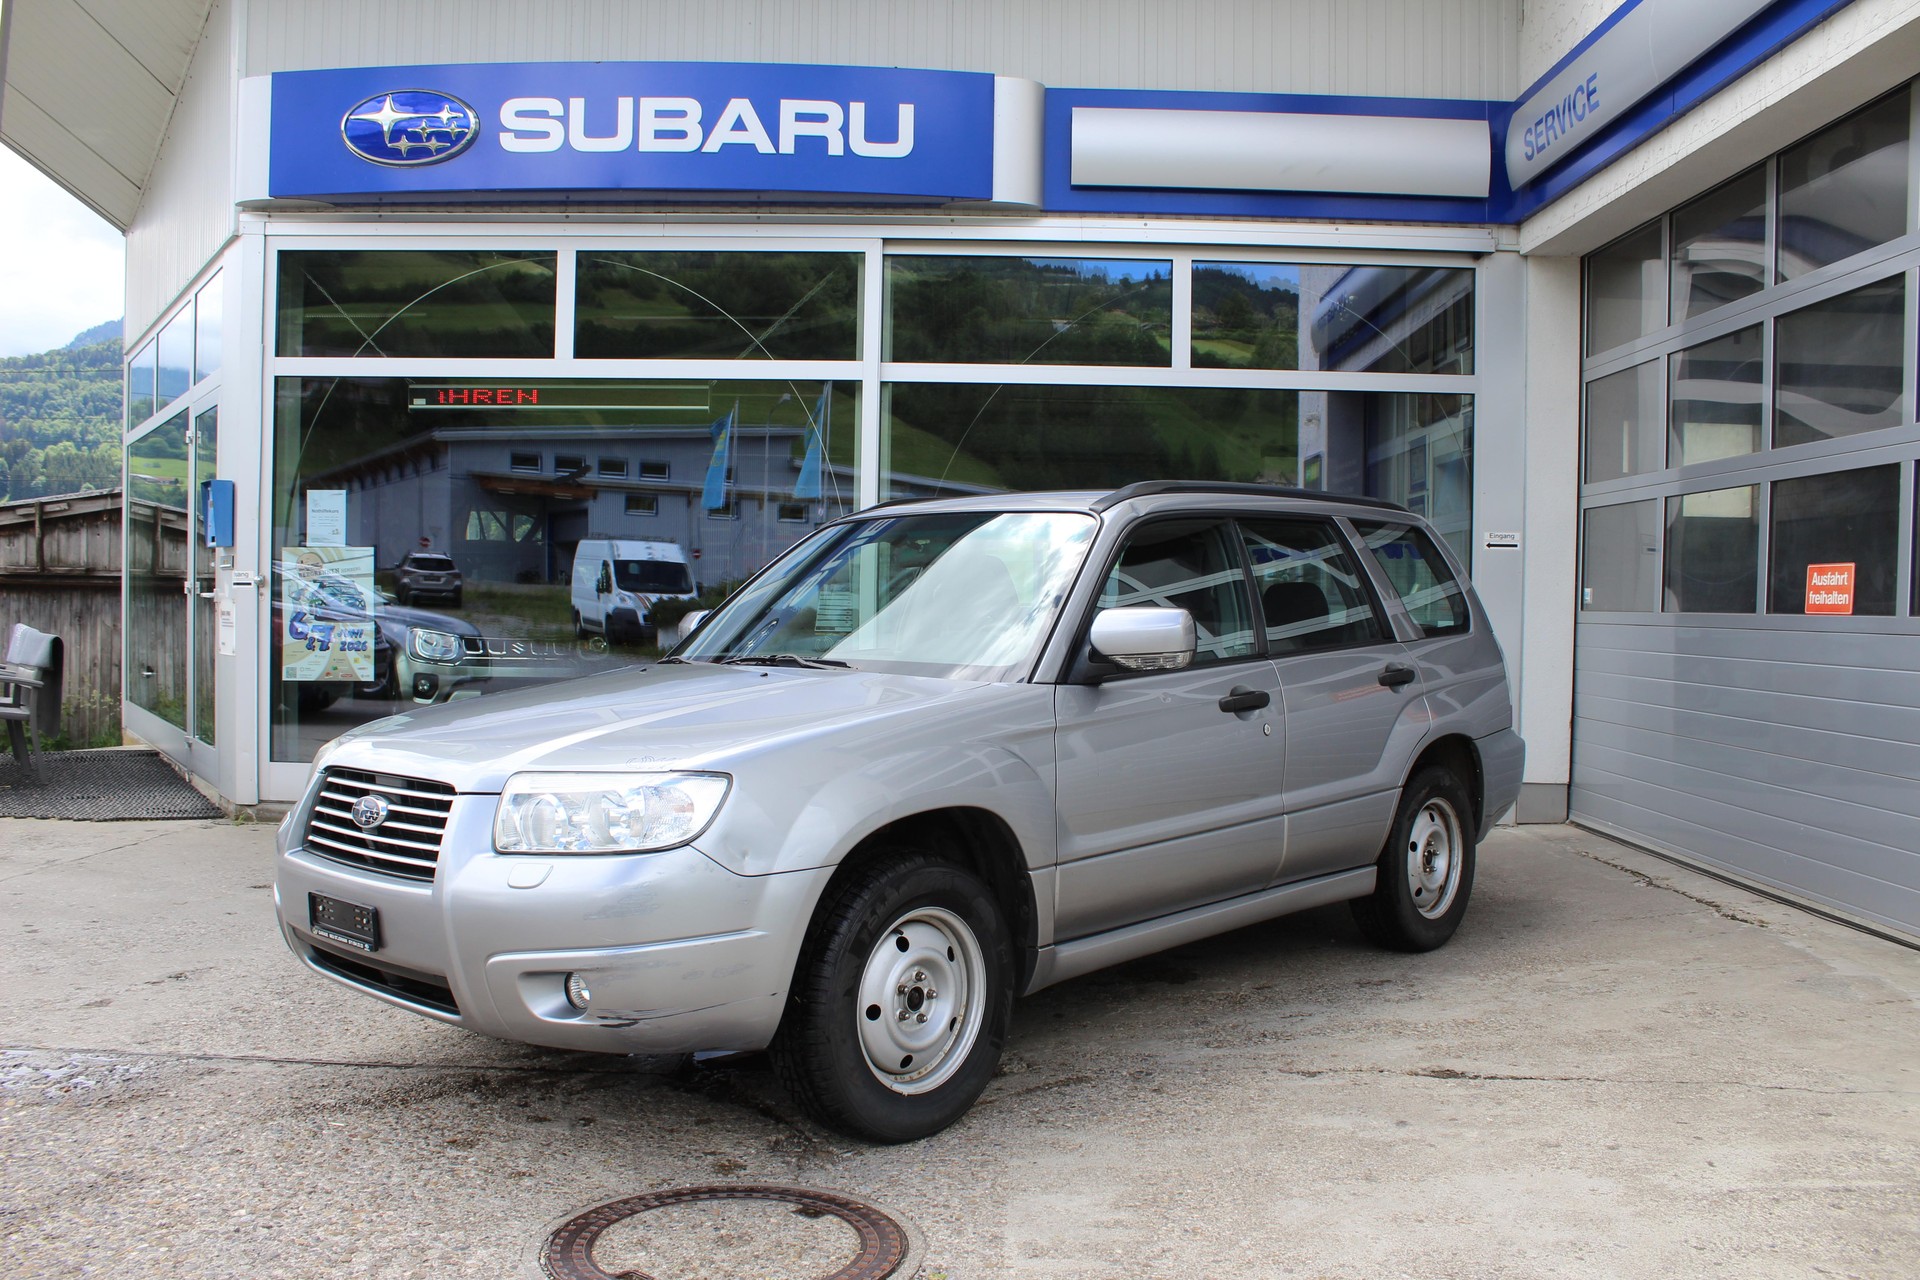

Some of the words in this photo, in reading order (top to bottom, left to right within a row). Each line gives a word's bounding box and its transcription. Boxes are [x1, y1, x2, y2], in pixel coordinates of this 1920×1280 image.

[1523, 72, 1600, 161] SERVICE
[500, 97, 914, 158] SUBARU
[1489, 532, 1516, 540] Eingang
[1811, 571, 1849, 586] Ausfahrt
[1808, 591, 1849, 605] freihalten
[339, 640, 368, 652] 2026
